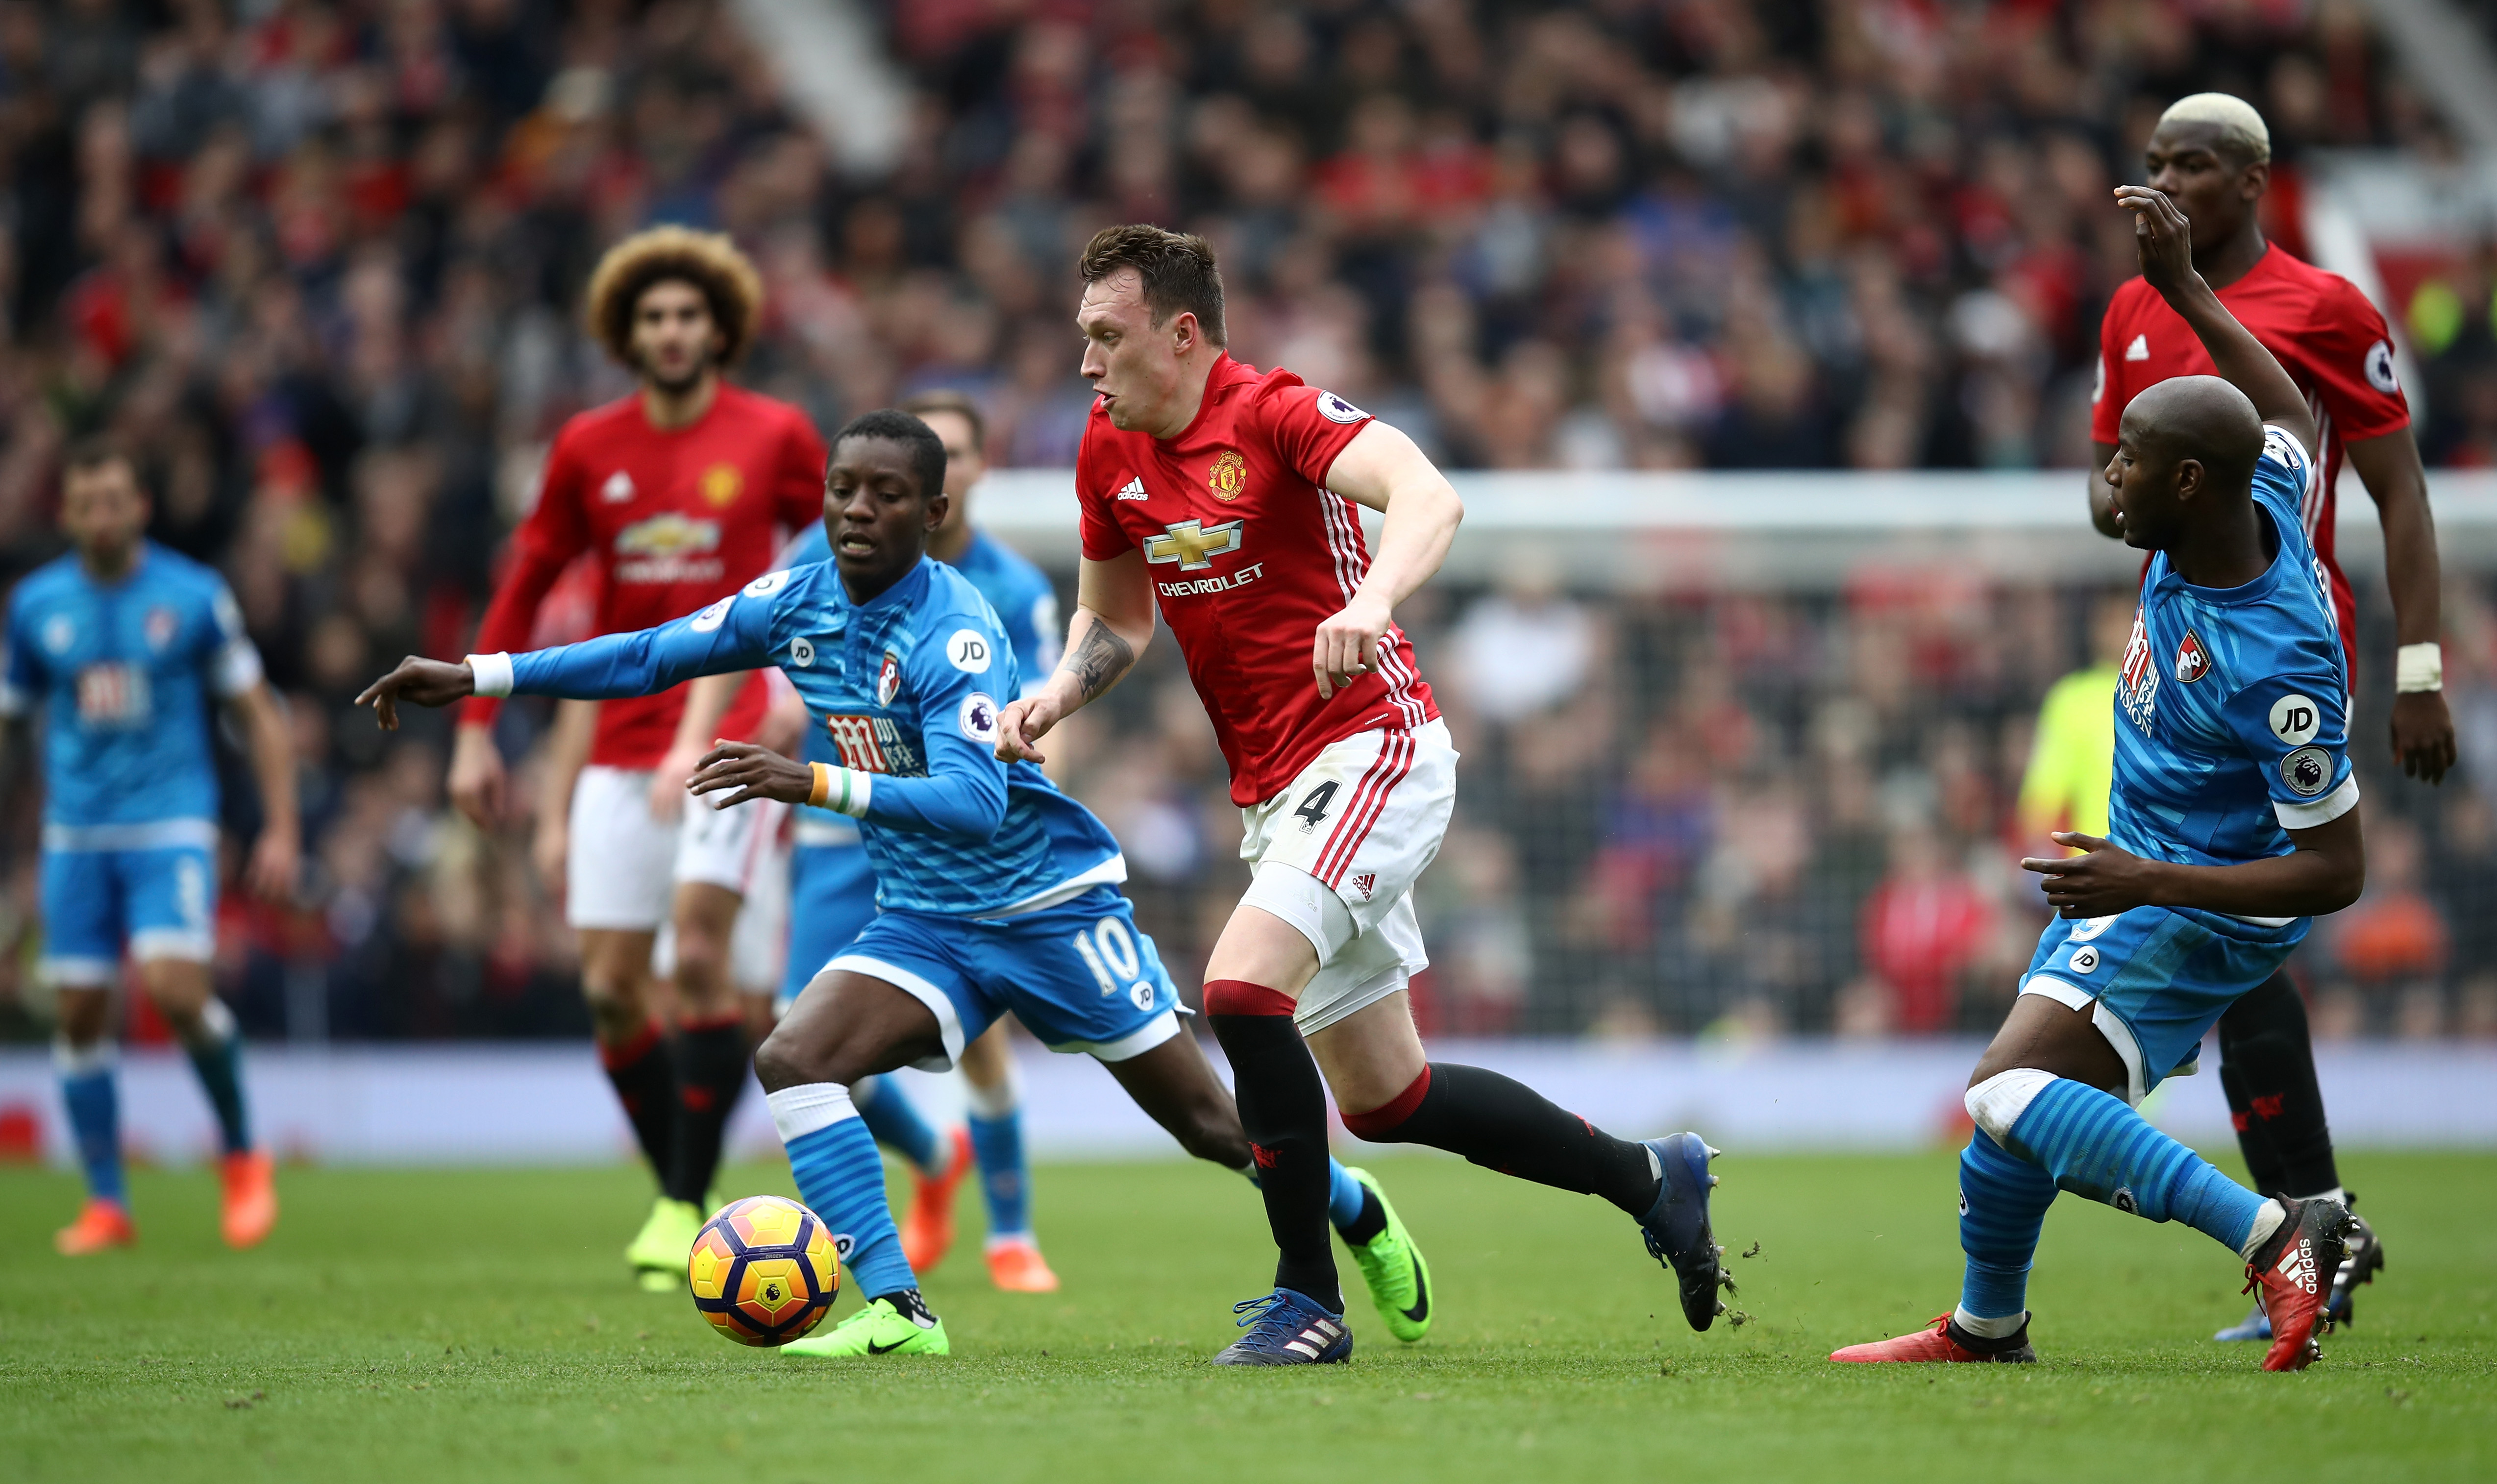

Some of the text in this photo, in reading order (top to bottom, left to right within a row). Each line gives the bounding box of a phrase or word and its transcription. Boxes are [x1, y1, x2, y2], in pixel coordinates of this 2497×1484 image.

[1213, 454, 1242, 475] MANCHESTER
[1117, 491, 1148, 501] adidas
[1219, 486, 1241, 497] UNITED
[1159, 562, 1263, 596] CHEVROLET
[796, 647, 809, 659] JD
[960, 642, 985, 663] JD
[2280, 707, 2313, 734] JD
[1291, 779, 1342, 834] 4
[1352, 877, 1371, 902] adidas
[1073, 916, 1140, 997] 10
[2074, 952, 2095, 967] JD
[1139, 989, 1151, 1005] JD
[2299, 1238, 2318, 1294] adidas
